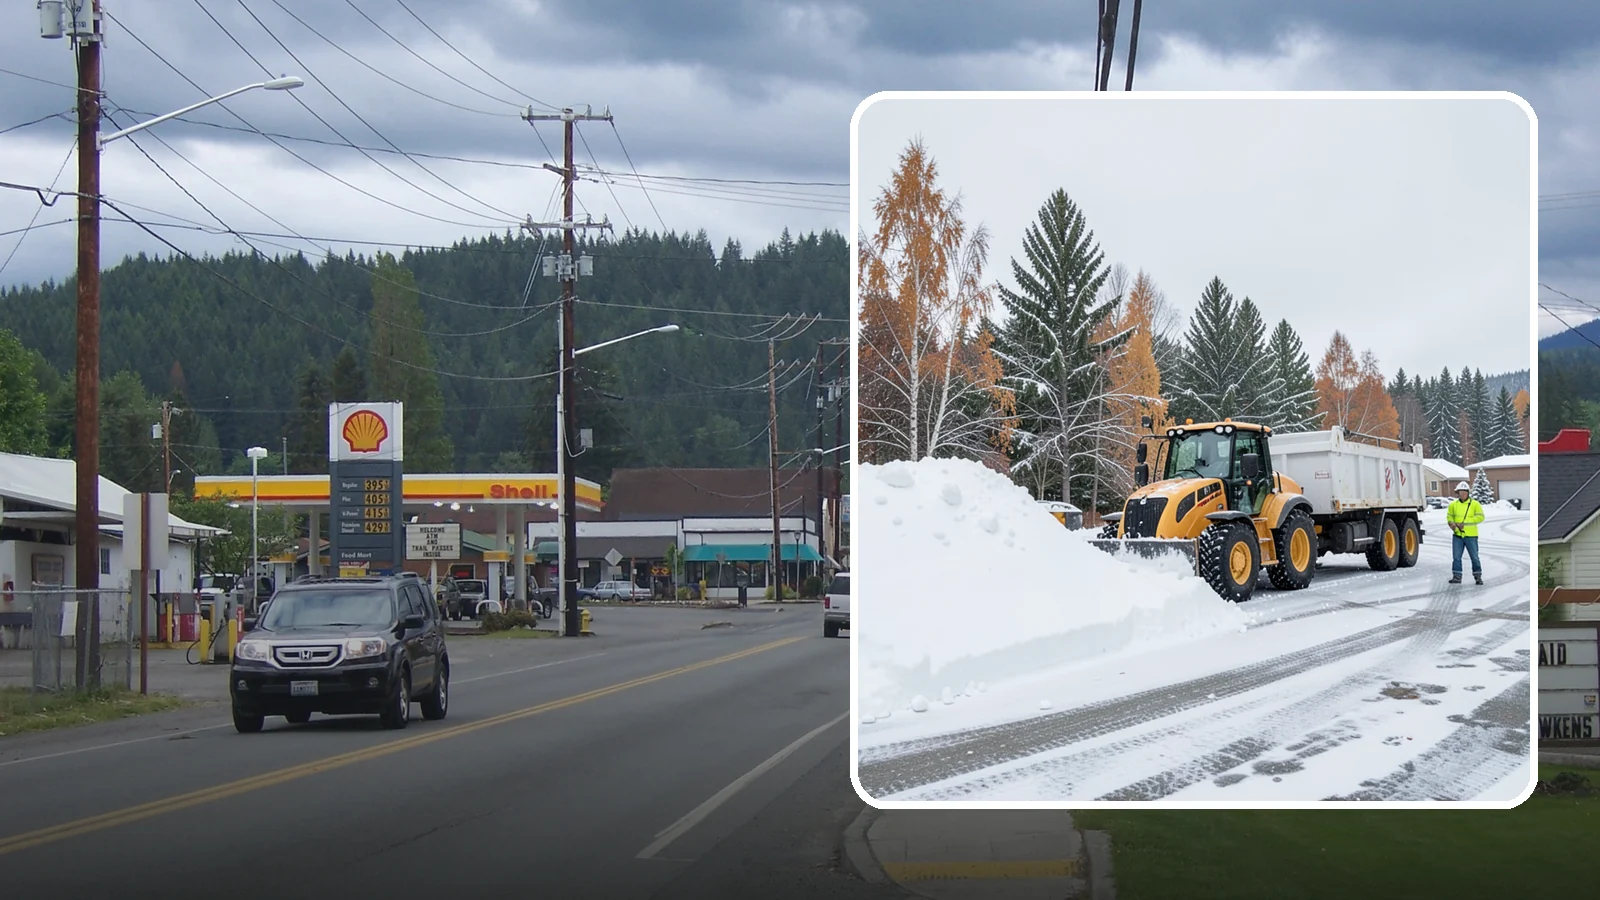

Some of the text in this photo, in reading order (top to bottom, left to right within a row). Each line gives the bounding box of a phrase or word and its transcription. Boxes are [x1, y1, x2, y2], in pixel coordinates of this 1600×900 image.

[366, 480, 383, 490] 395
[490, 484, 547, 499] Shell
[366, 494, 383, 504] 405
[366, 508, 383, 518] 415
[366, 522, 383, 532] 429
